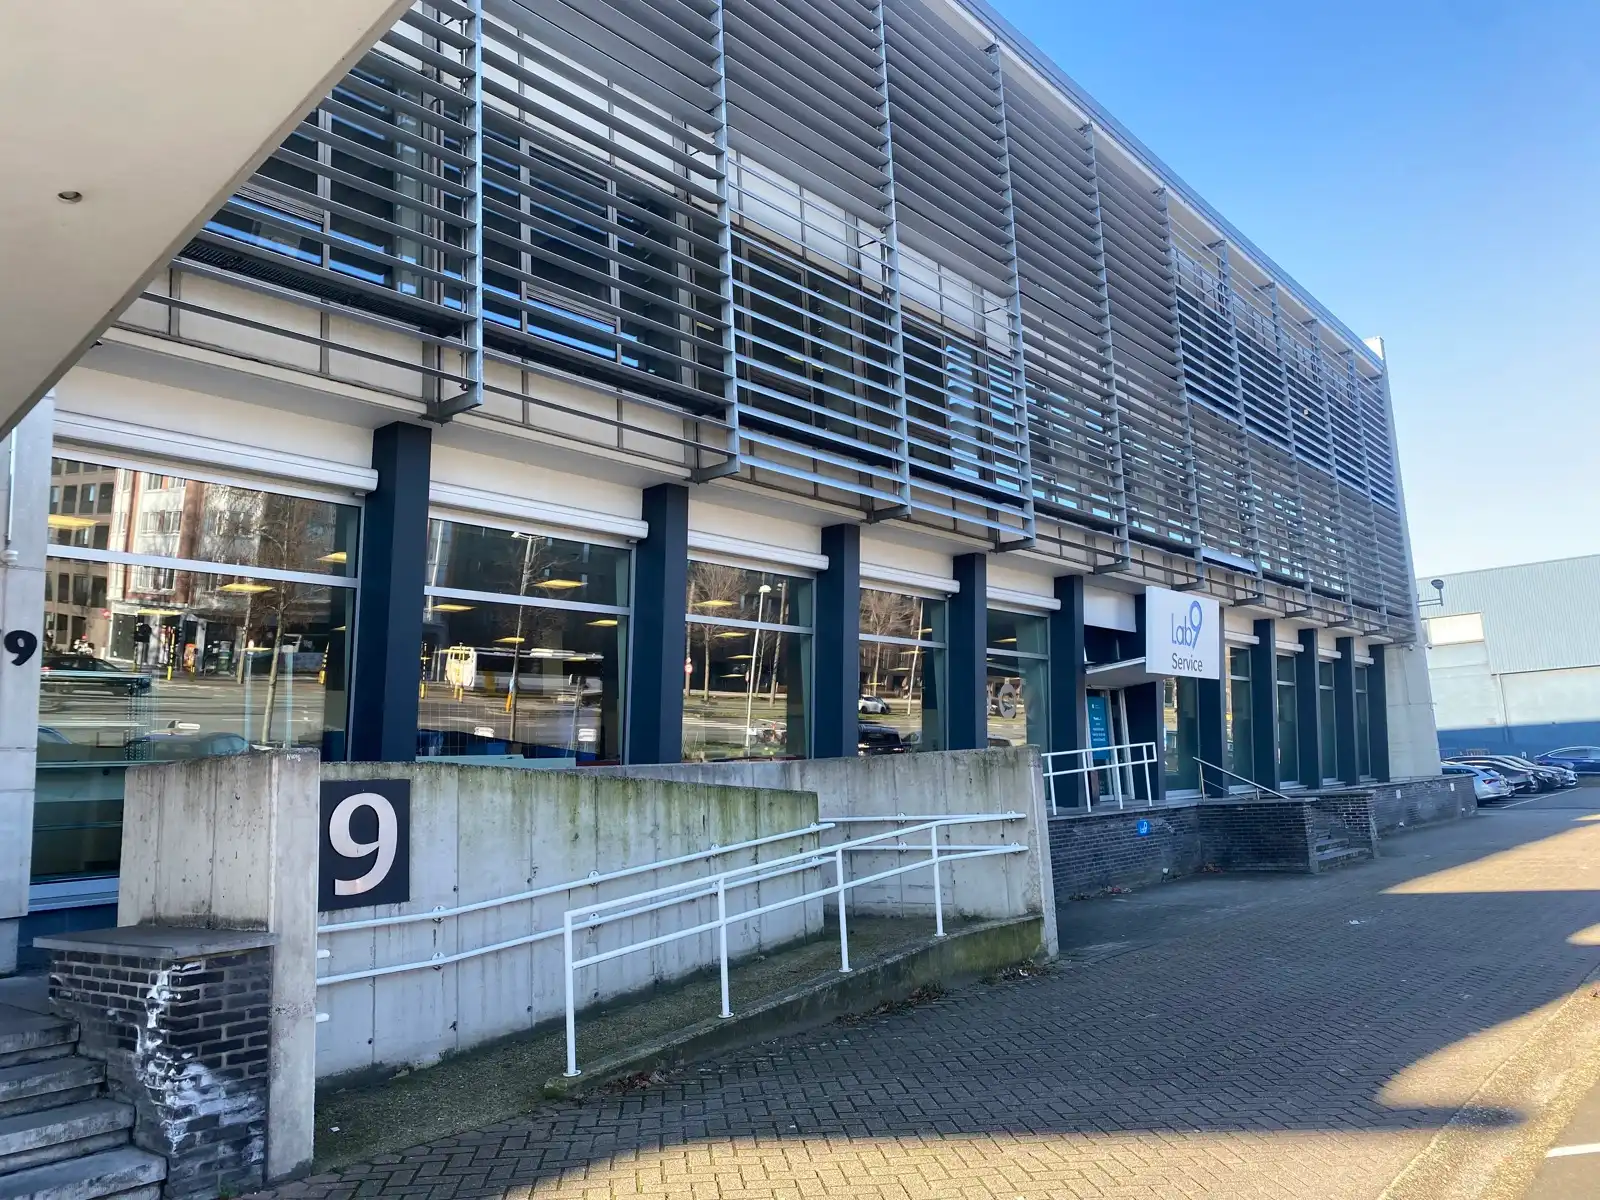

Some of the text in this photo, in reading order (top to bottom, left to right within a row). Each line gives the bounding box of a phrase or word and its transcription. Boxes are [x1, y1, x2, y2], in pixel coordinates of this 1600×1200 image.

[1171, 600, 1203, 650] Lab9
[4, 630, 37, 666] 9
[1171, 652, 1203, 672] Service
[329, 792, 398, 896] 9
